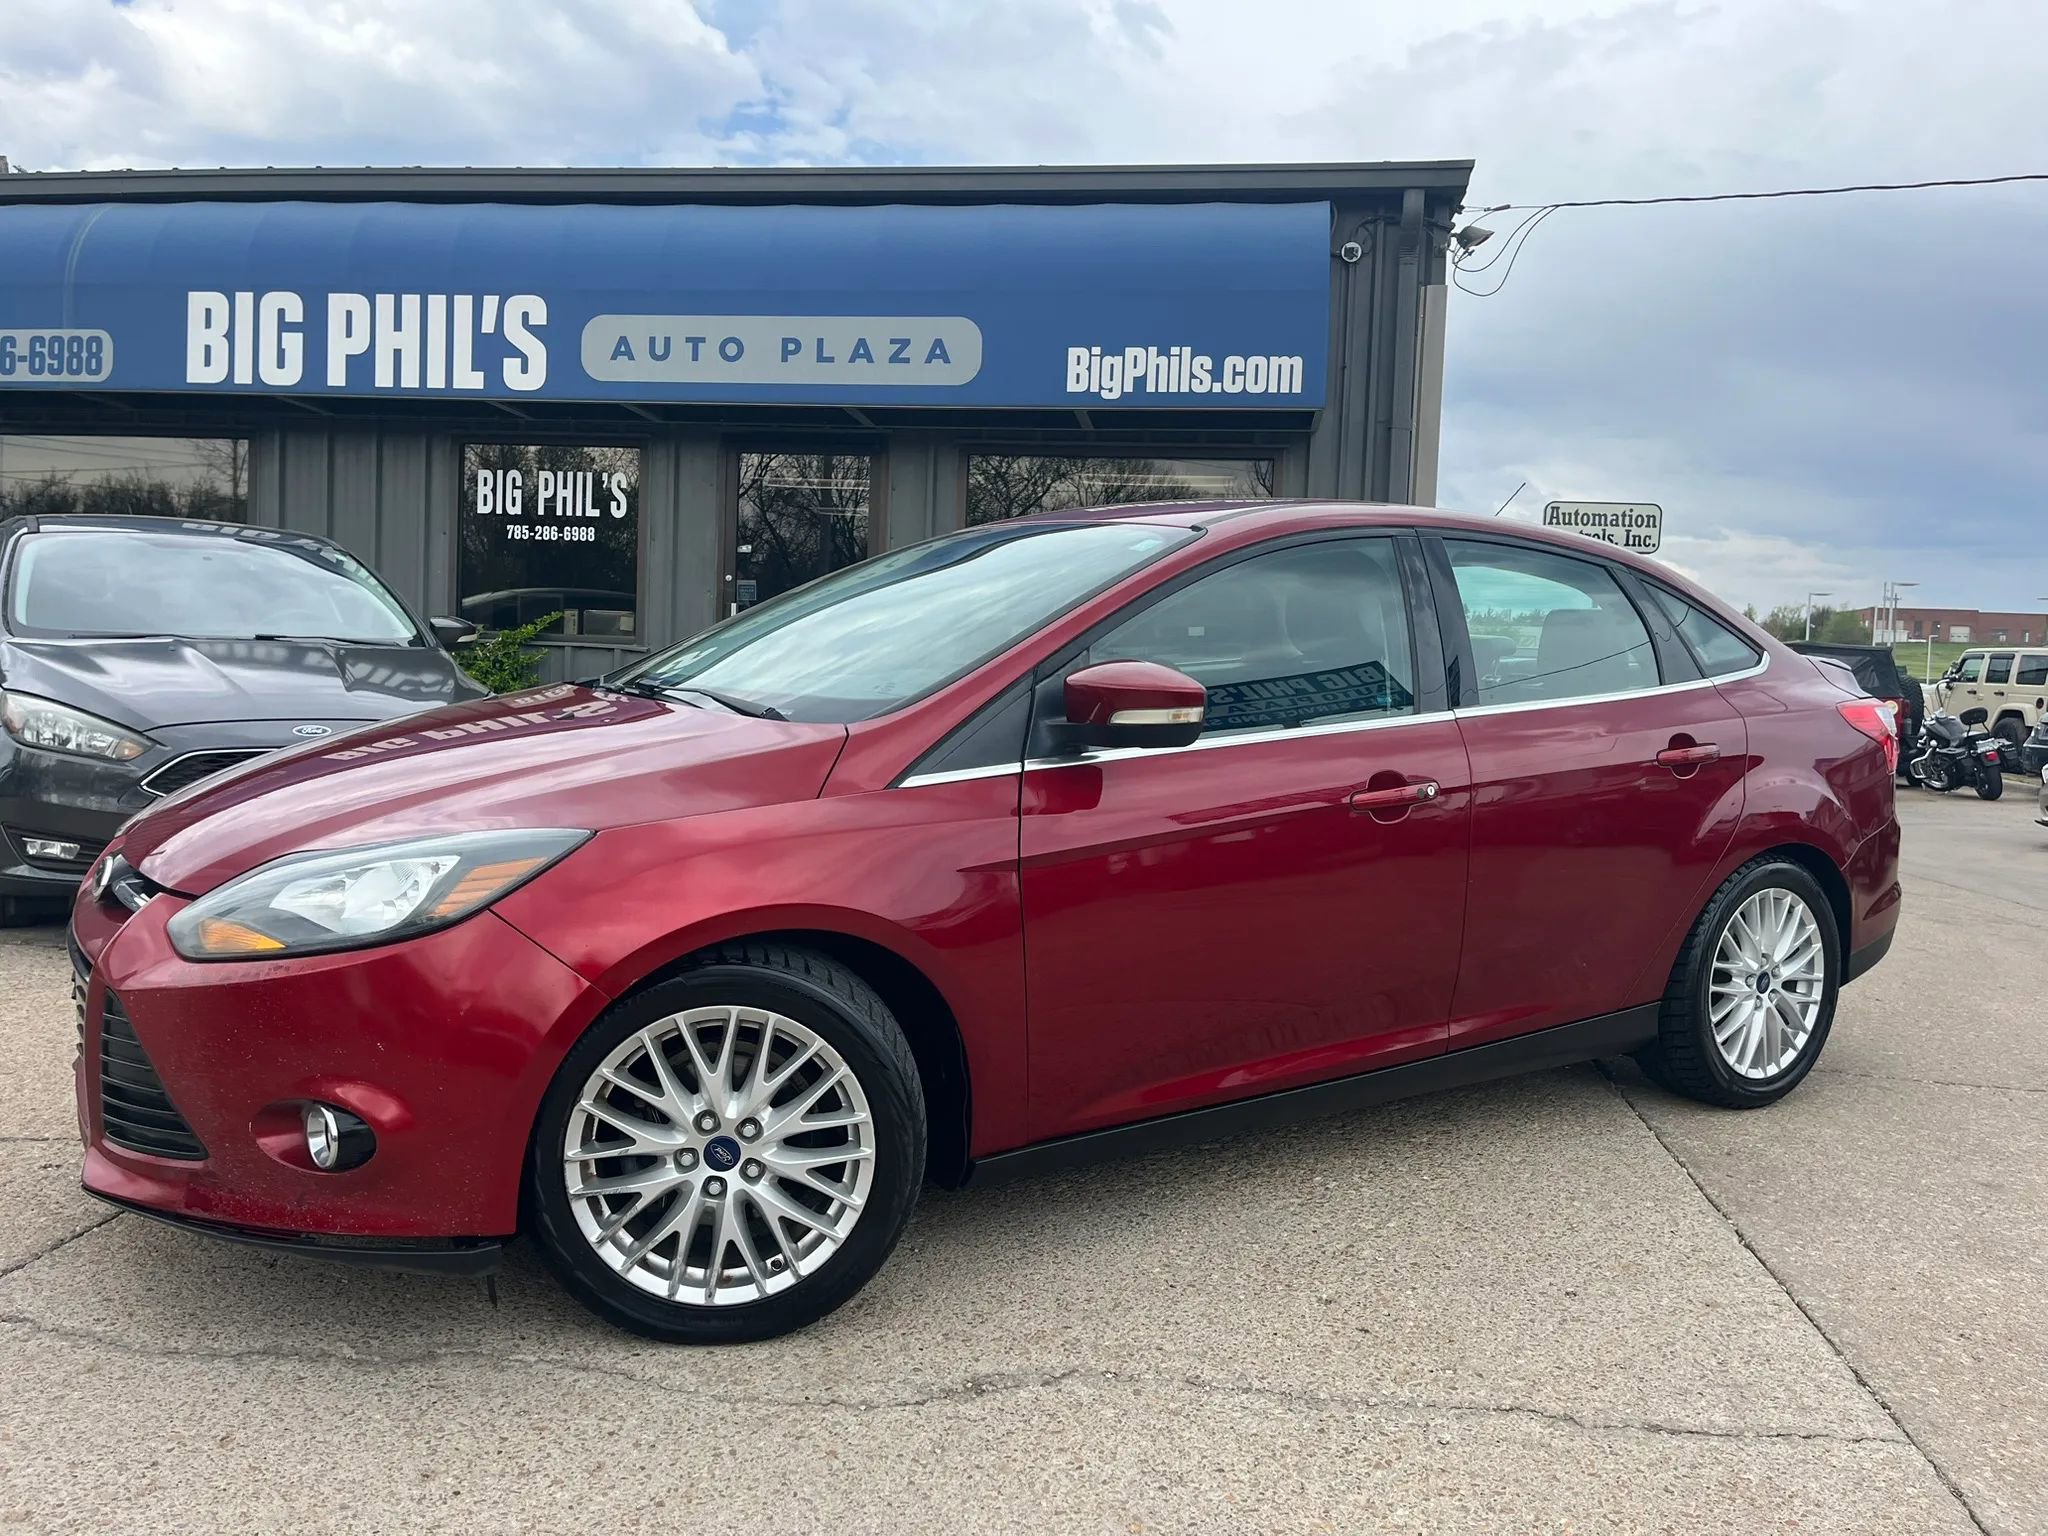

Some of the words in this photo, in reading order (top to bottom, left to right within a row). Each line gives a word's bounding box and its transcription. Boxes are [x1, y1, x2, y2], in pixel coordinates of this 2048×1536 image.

[0, 335, 103, 376] 6-6988
[186, 291, 304, 386] BIG
[326, 293, 547, 391] PHIL'S
[609, 335, 745, 363] AUTO
[780, 337, 951, 364] PLAZA
[1066, 346, 1304, 400] BigPhils.com
[476, 469, 523, 515] BIG
[537, 470, 628, 519] PHIL'S
[506, 524, 596, 542] 785-286-6988
[1547, 506, 1657, 529] Automation
[1623, 529, 1657, 548] Inc.
